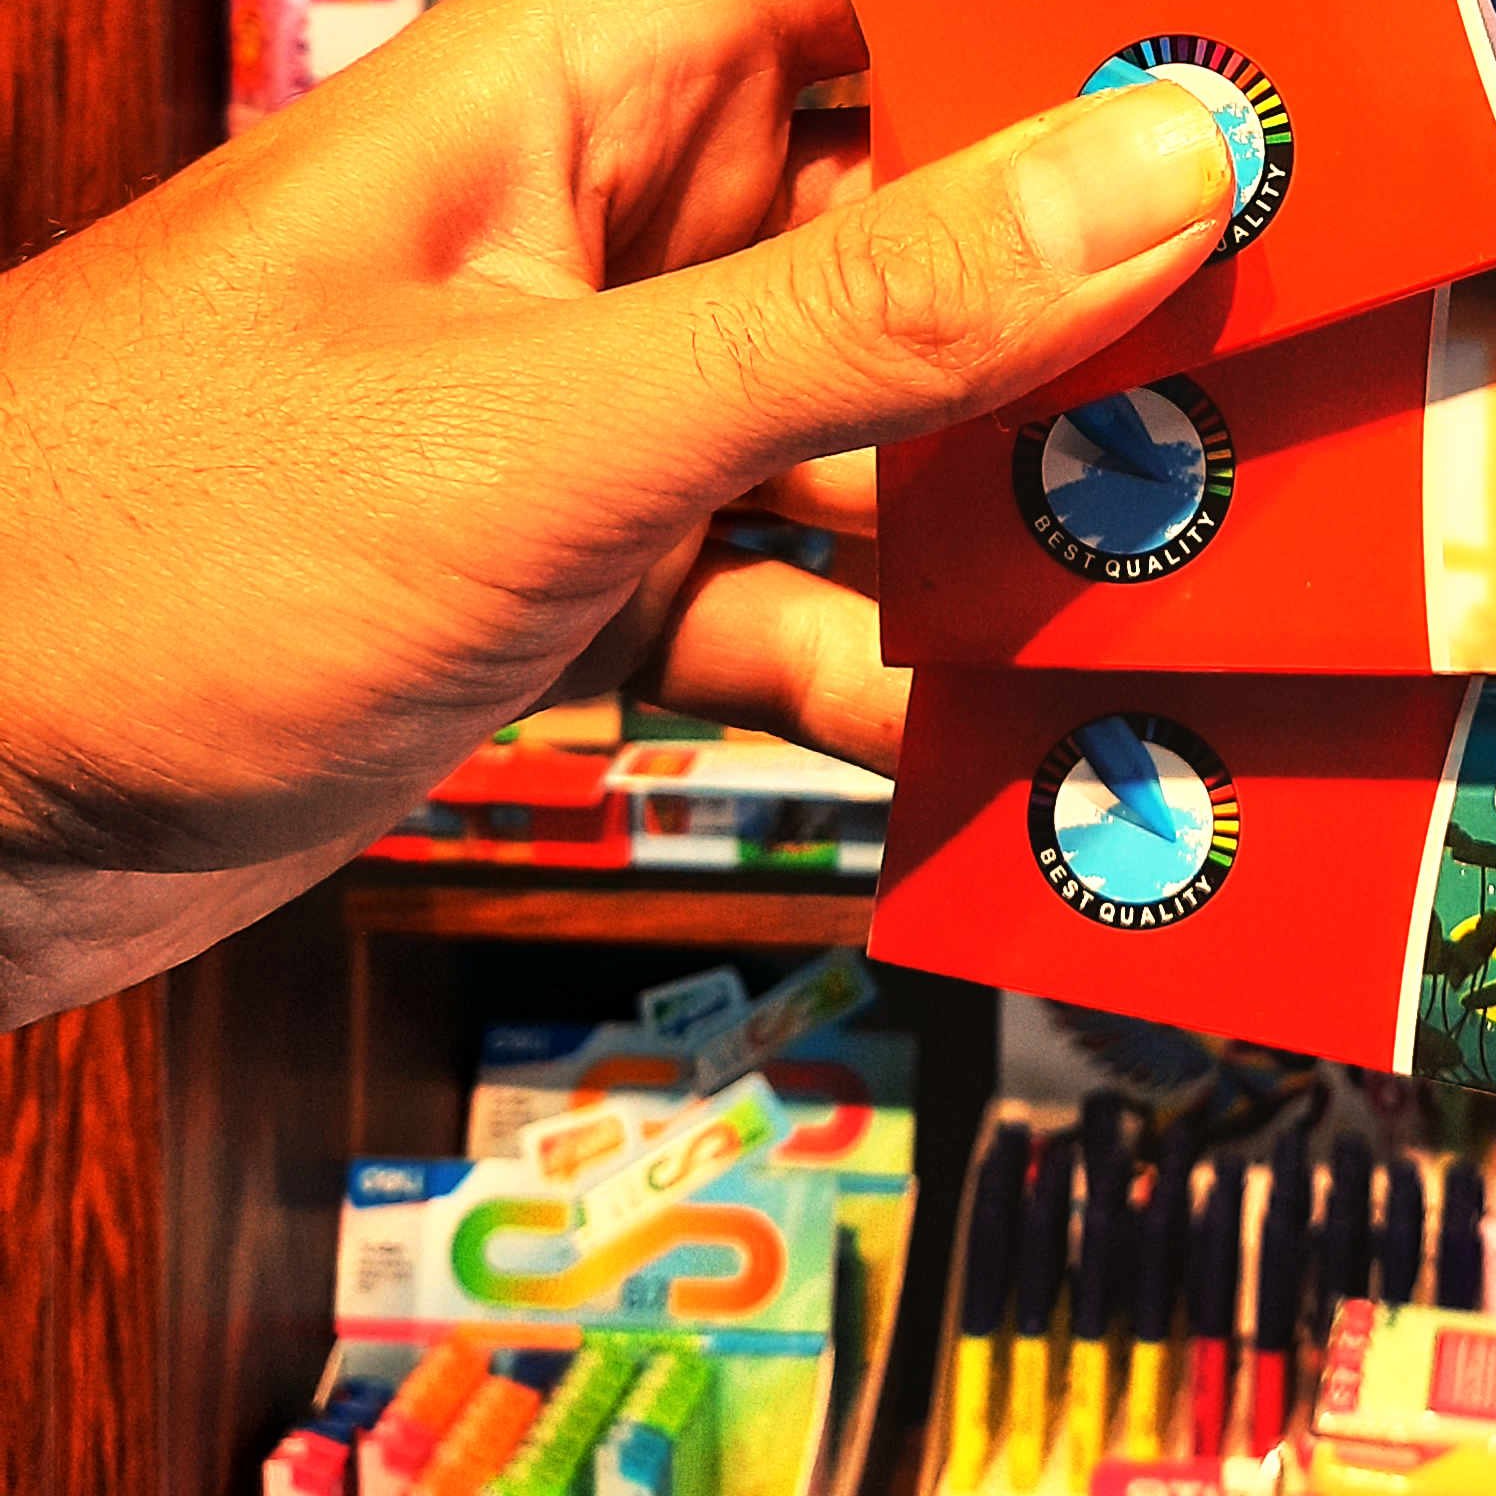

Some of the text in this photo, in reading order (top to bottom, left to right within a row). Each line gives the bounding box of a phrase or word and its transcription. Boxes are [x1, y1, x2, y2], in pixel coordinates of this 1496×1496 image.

[1216, 162, 1287, 253] UALITY
[1034, 511, 1215, 579] BEST QUALITY
[1040, 848, 1212, 927] BEST QUALITY
